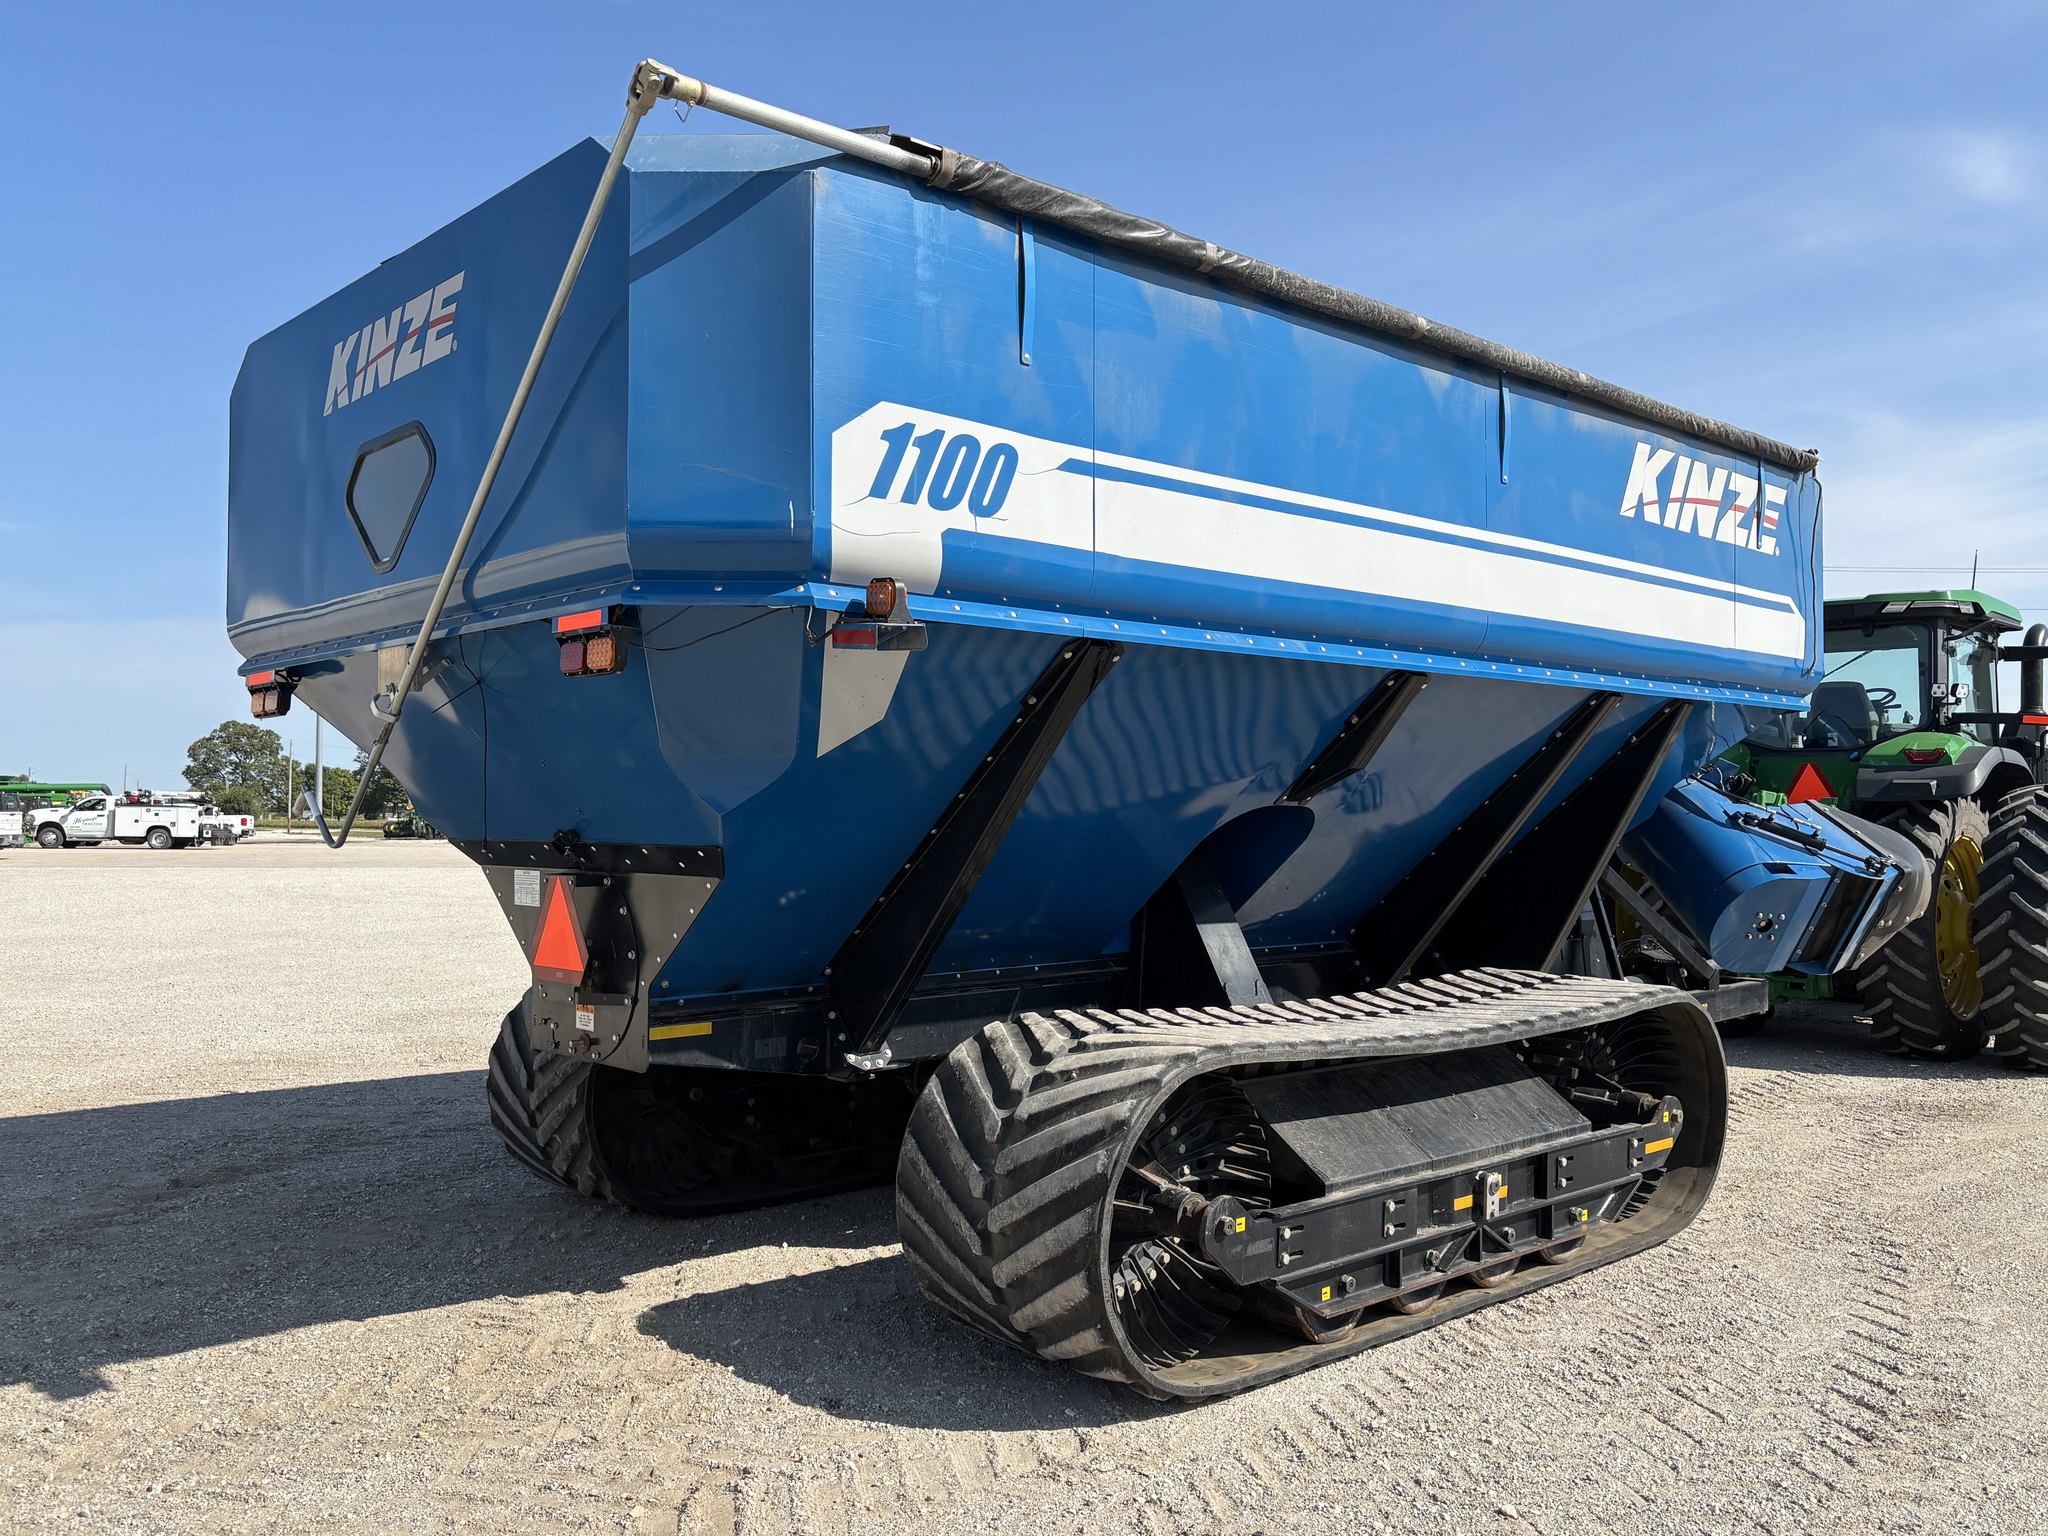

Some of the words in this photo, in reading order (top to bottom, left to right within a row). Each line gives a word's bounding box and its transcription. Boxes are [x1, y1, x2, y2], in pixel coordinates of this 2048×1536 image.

[323, 270, 465, 417] KINZE
[868, 422, 1019, 518] 1100
[1620, 441, 1787, 556] KINZE
